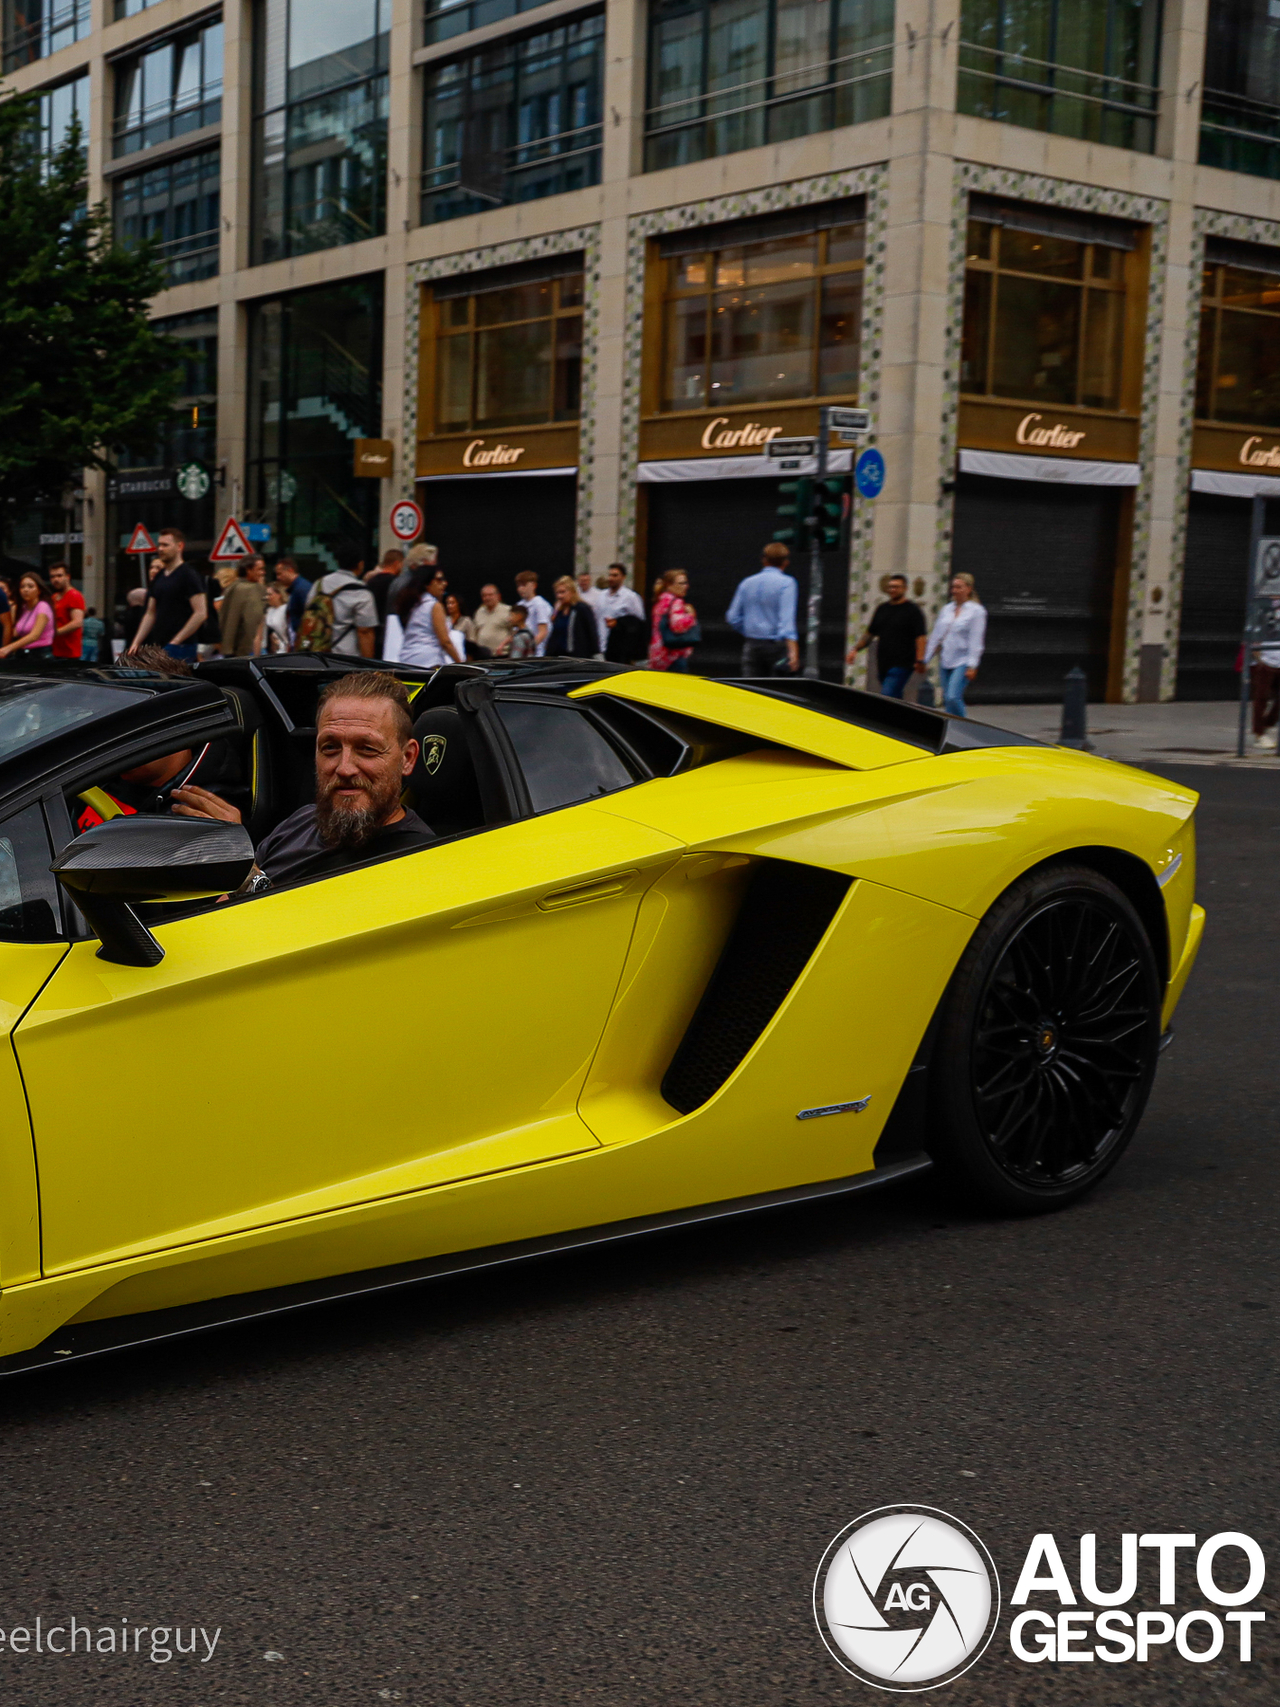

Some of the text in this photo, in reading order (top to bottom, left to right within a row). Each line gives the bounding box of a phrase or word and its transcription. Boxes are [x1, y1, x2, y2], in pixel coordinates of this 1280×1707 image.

[700, 417, 783, 449] Cartier
[1015, 412, 1086, 449] Cartier
[462, 439, 525, 468] Cartier
[120, 478, 171, 495] STARBUCKS
[396, 512, 417, 531] 30
[39, 532, 84, 546] STARBCKS
